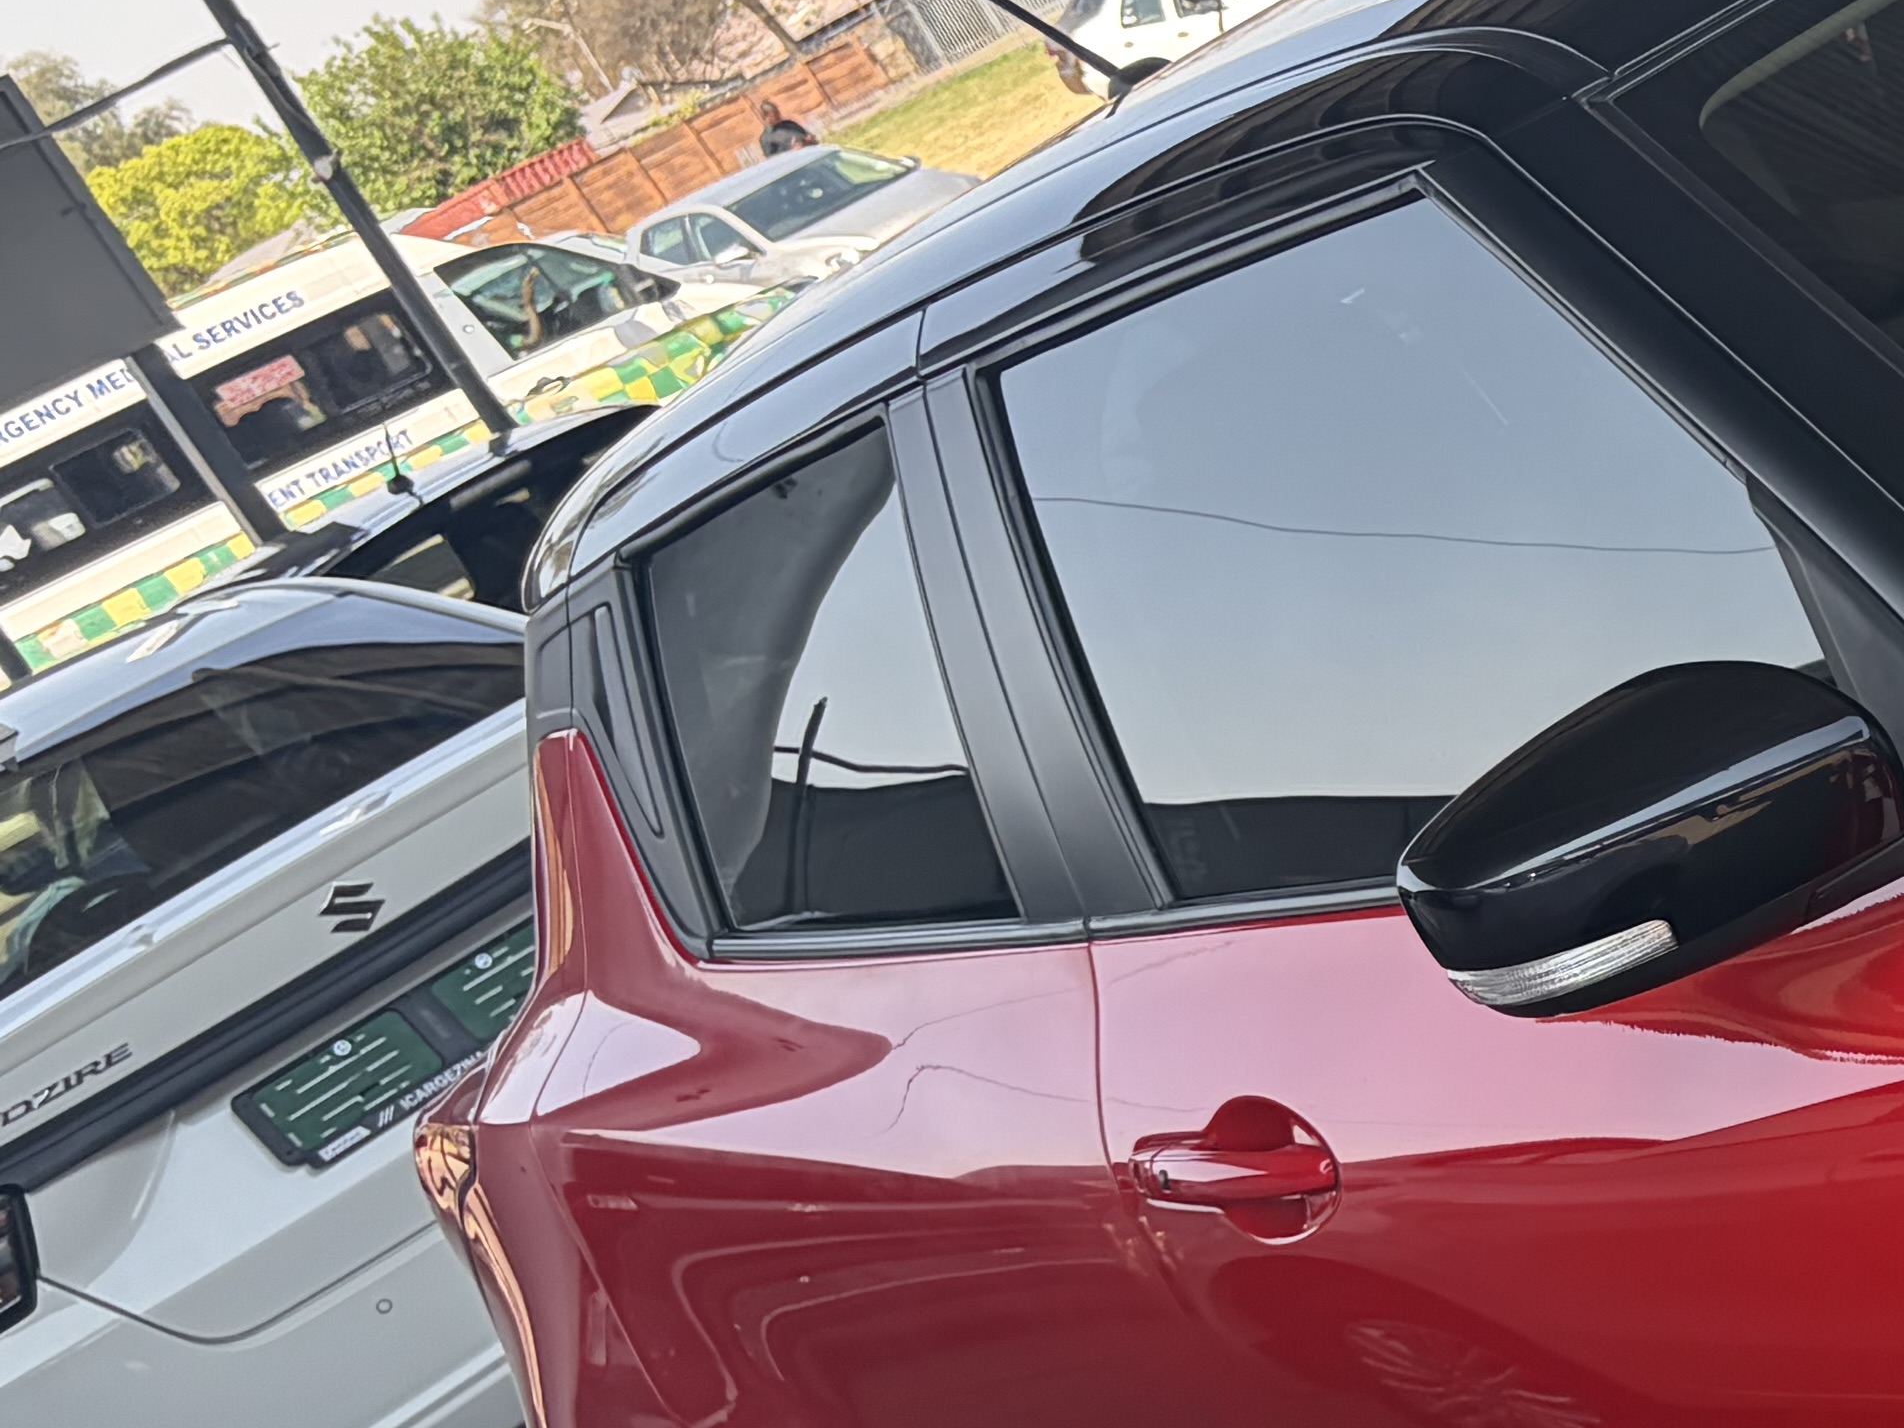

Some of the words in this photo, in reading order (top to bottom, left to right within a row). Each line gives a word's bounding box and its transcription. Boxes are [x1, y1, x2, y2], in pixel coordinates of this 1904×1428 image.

[192, 290, 305, 350] SERVICES
[305, 428, 413, 487] TRANSPORT
[1, 1041, 133, 1127] DZIRE
